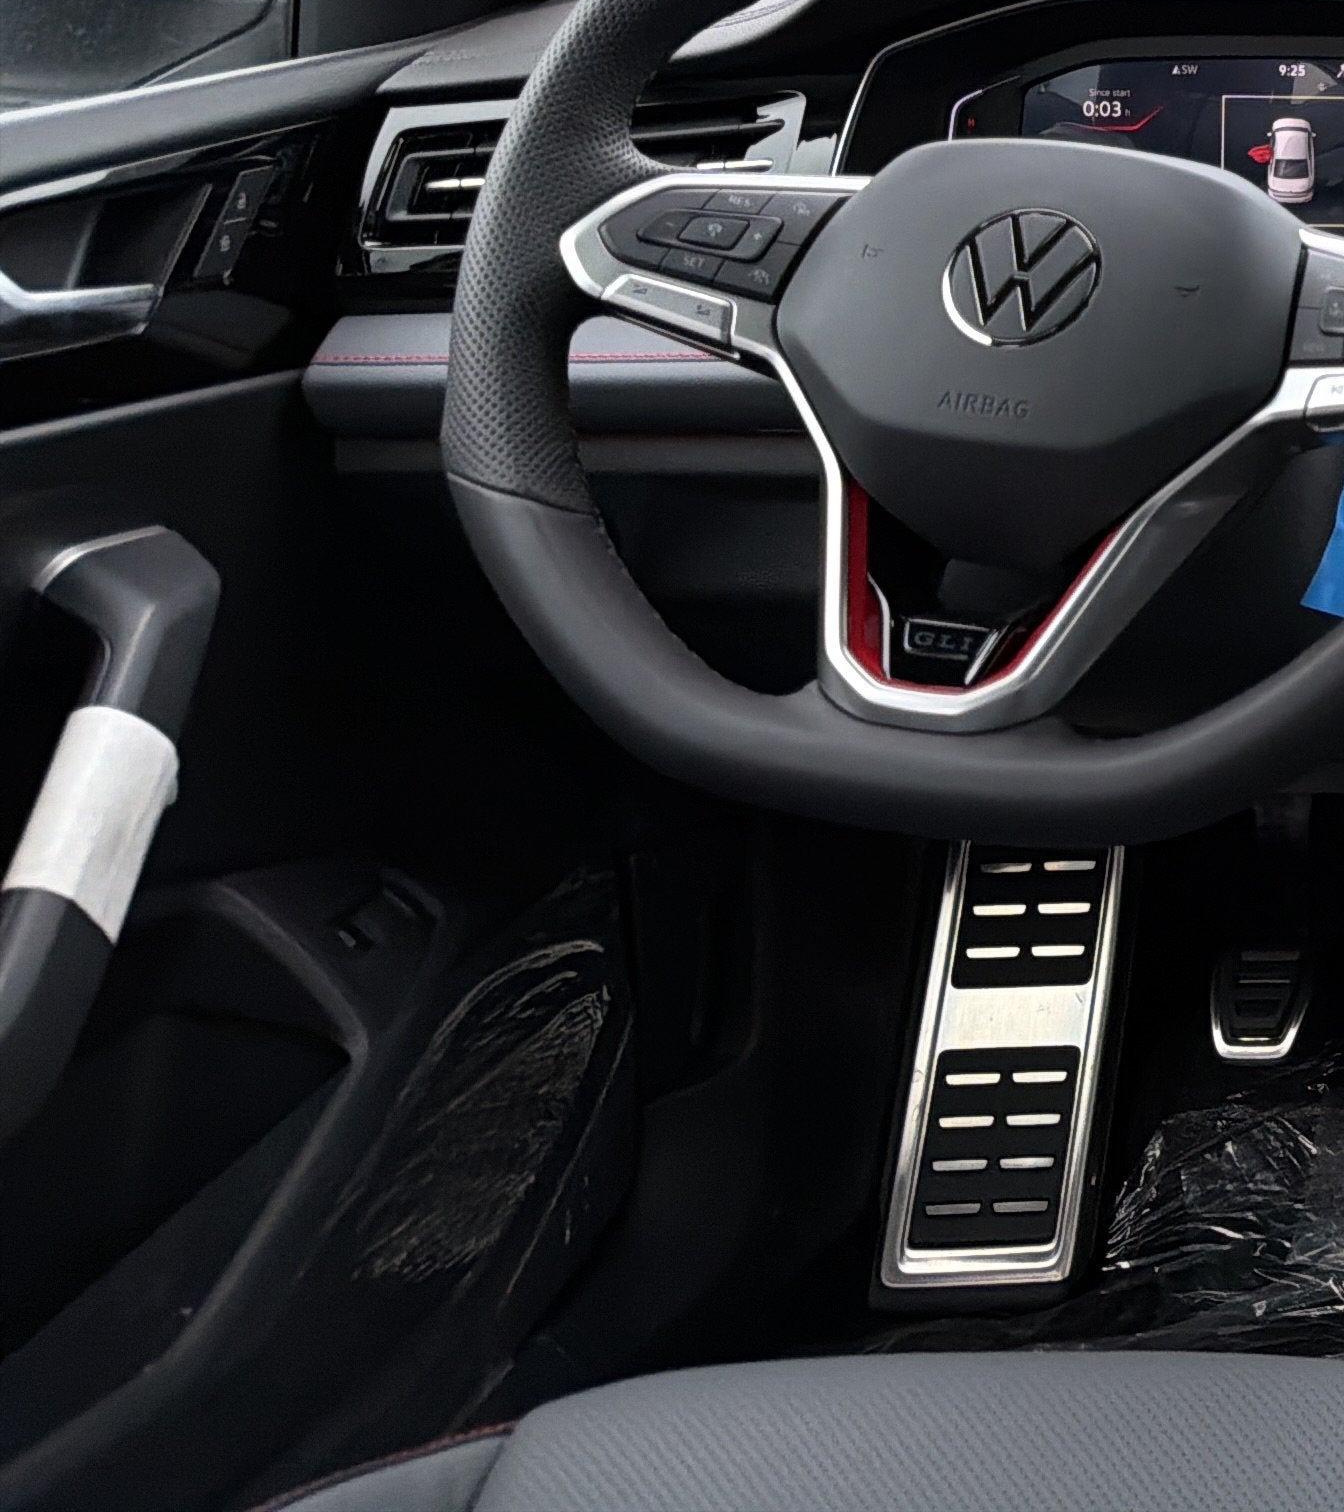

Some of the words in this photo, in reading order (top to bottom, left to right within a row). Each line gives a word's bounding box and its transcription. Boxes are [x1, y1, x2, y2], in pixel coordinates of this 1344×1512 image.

[1181, 64, 1199, 75] SW
[1278, 64, 1307, 78] 9:25
[1088, 88, 1111, 97] Since
[1112, 89, 1131, 97] start
[1082, 100, 1122, 118] 0:03
[683, 255, 706, 271] SET
[941, 206, 1103, 348] VW
[936, 390, 1030, 419] AIRBAG
[913, 631, 974, 651] GLI
